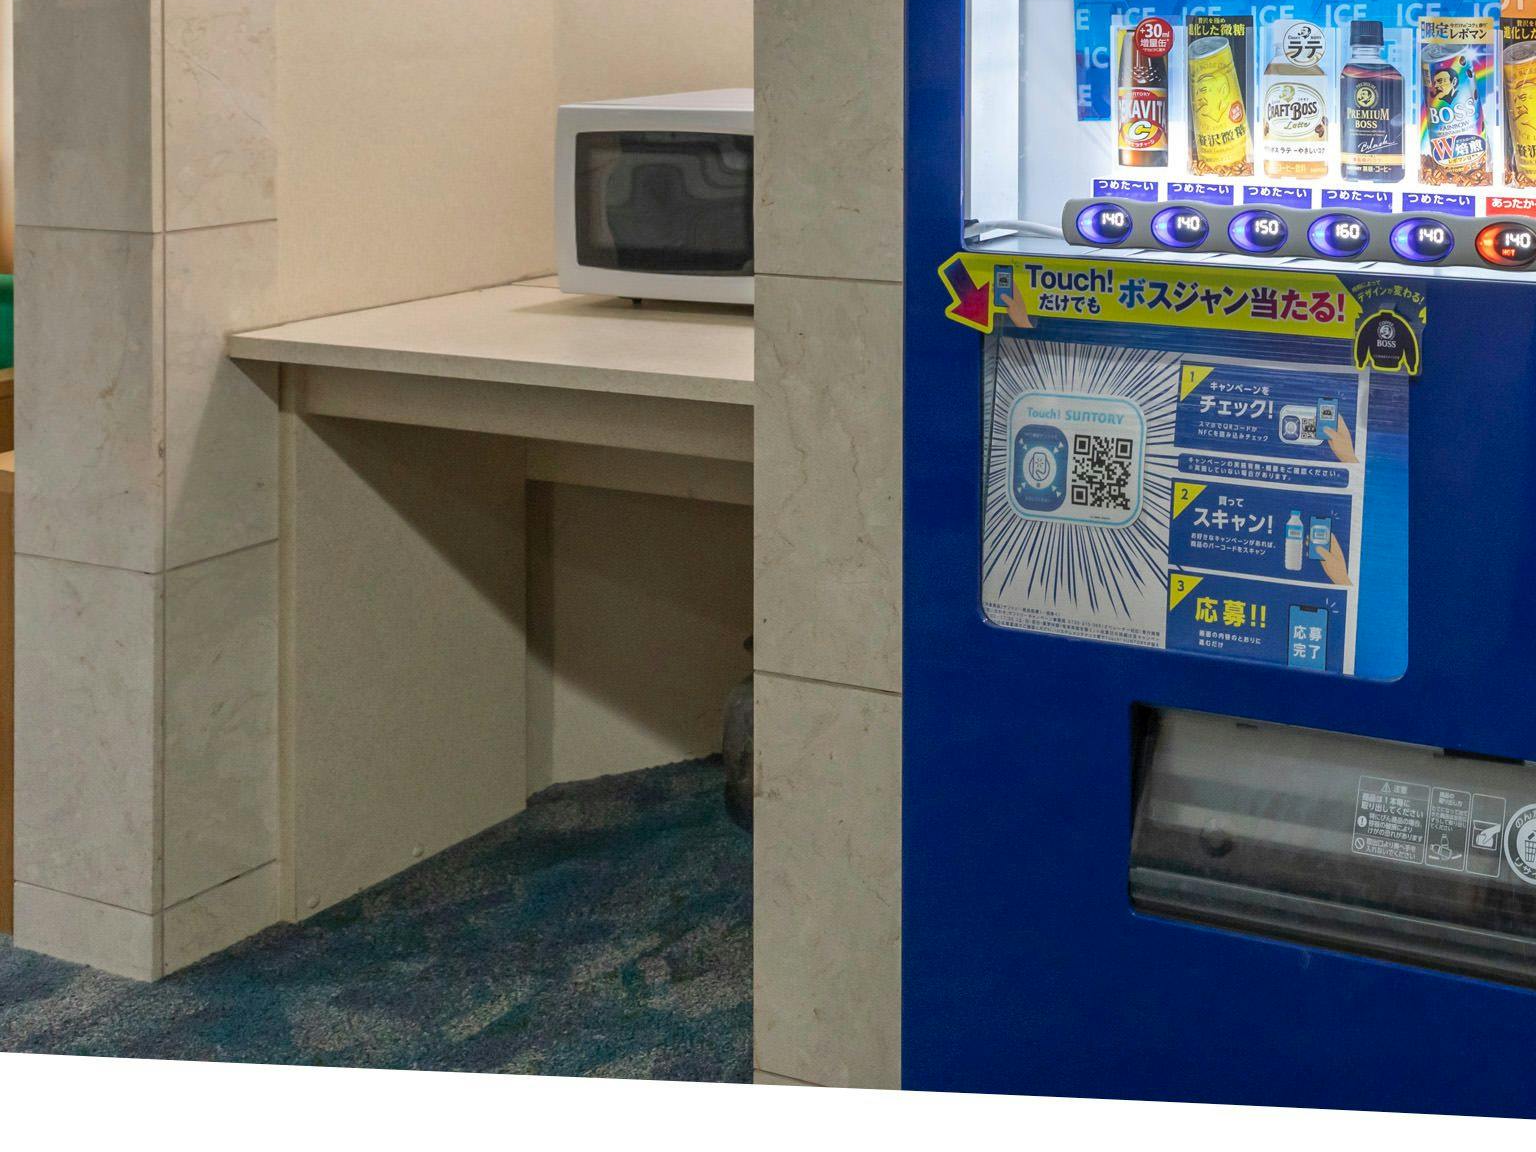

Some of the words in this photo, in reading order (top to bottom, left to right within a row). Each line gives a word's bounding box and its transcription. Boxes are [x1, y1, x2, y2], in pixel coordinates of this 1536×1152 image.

[1450, 28, 1488, 40] レボマン
[1288, 39, 1323, 59] ラテ
[1346, 107, 1390, 121] PREMIUM
[1429, 99, 1475, 125] BOSS
[1283, 121, 1311, 130] Latte
[1355, 120, 1378, 129] BOSS
[1101, 213, 1124, 227] 140
[1176, 216, 1201, 230] 140
[1255, 220, 1279, 235] 150
[1335, 223, 1360, 238] 160
[1418, 228, 1444, 244] 140
[1024, 263, 1113, 294] Touch!
[1038, 293, 1101, 315] だけでも
[1118, 278, 1346, 325] ボスジャン当たる!
[1377, 339, 1396, 348] BOSS
[1210, 381, 1270, 395] キャンペーンを
[1200, 395, 1273, 419] チェック!
[1027, 406, 1061, 420] Touch!
[1065, 409, 1125, 425] SUNTORY
[1218, 496, 1244, 508] 買って
[1192, 507, 1273, 534] スキャン!
[1194, 596, 1267, 628] 応募!!
[1293, 625, 1323, 640] 応募
[1293, 644, 1321, 660] 完了
